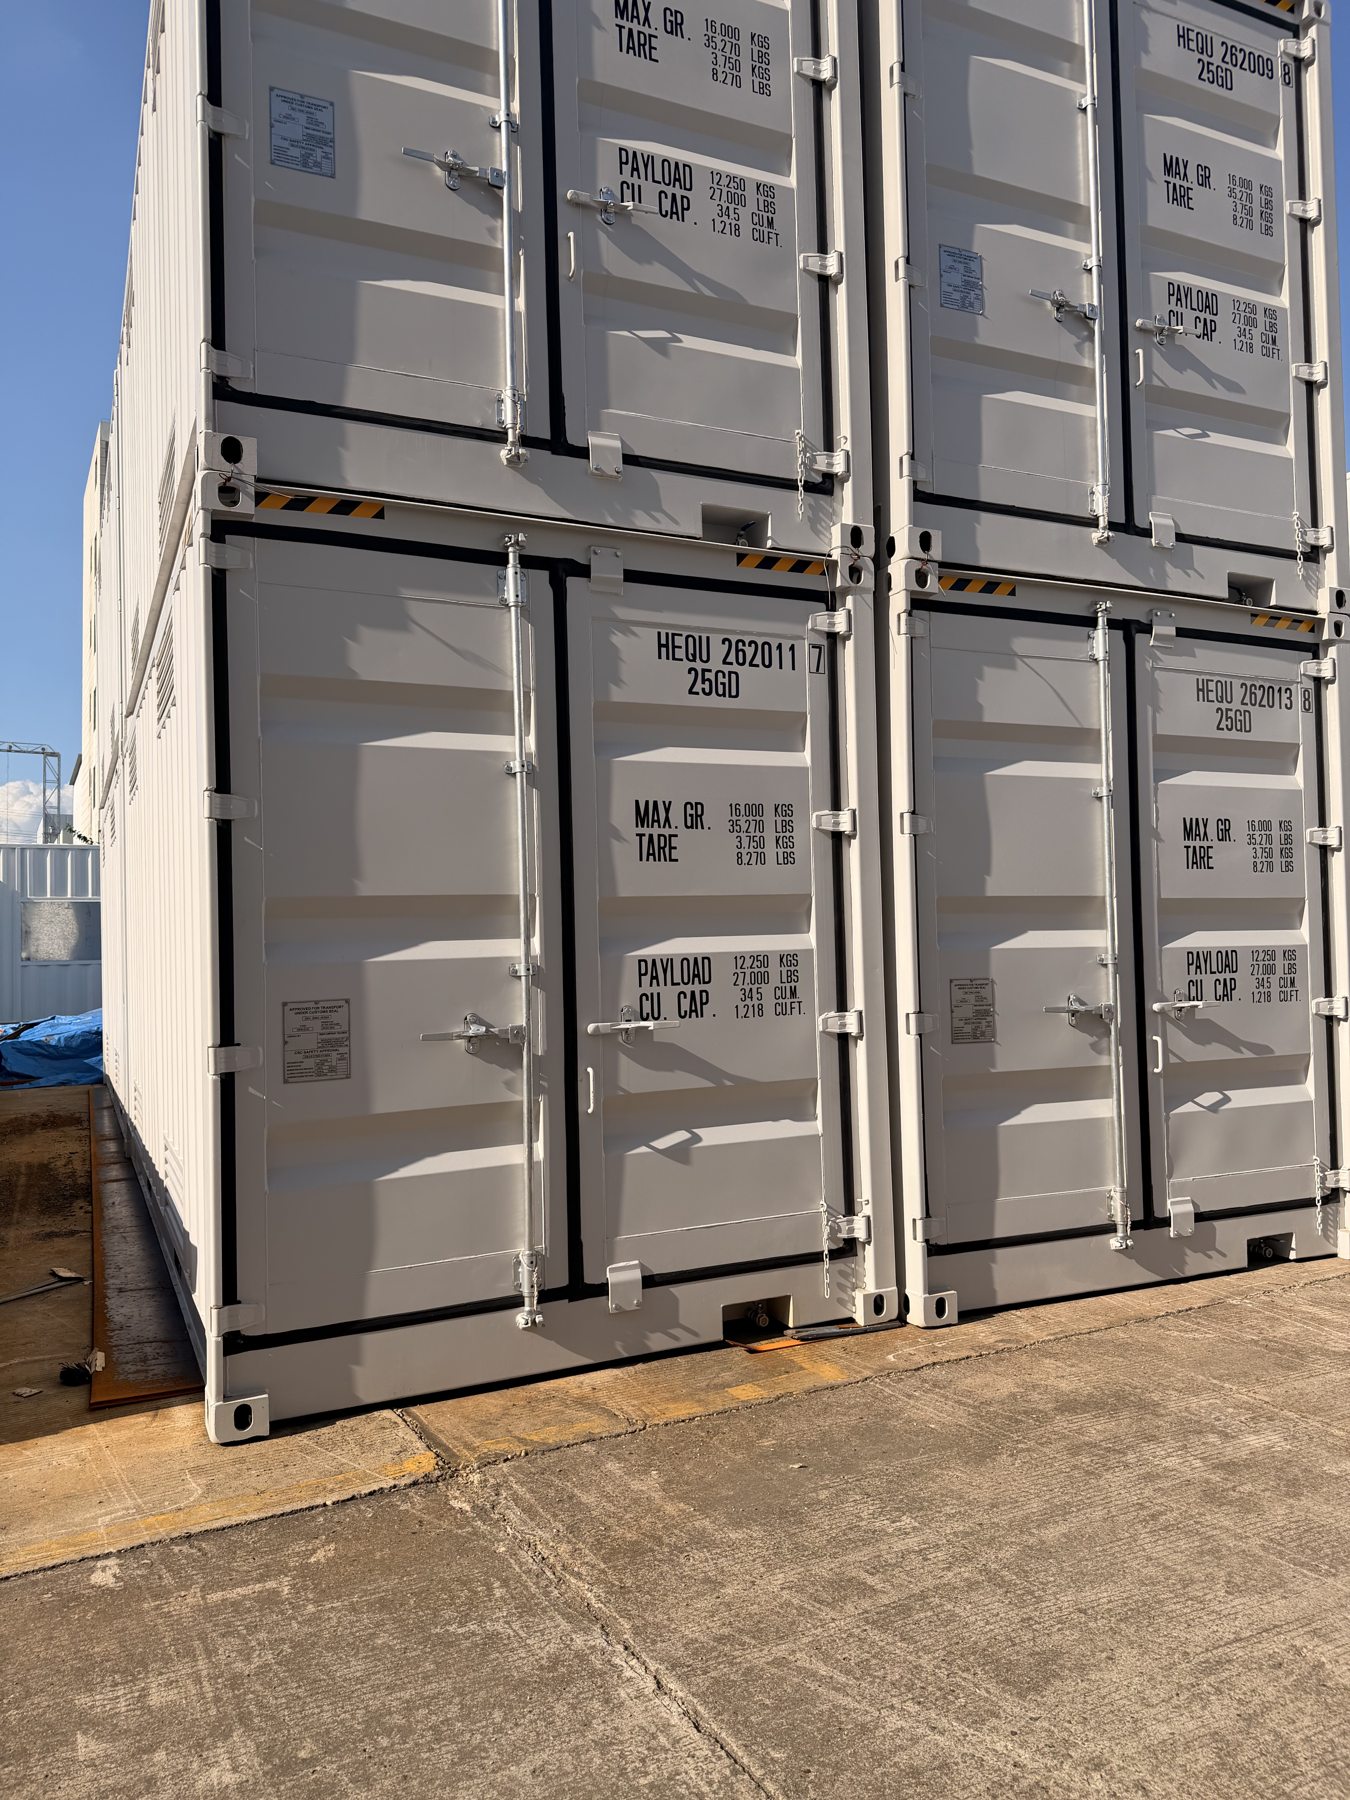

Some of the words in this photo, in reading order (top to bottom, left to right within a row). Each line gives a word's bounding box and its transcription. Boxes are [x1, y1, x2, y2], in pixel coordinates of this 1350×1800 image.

[614, 0, 658, 31] MAX.
[663, 7, 691, 41] GR.
[615, 23, 659, 63] TARE
[705, 18, 740, 42] 16.000
[750, 31, 770, 50] KGS
[704, 33, 741, 57] 35.270
[751, 47, 770, 66] LBS
[1177, 24, 1214, 58] HEQU
[1221, 41, 1274, 80] 262009
[711, 51, 741, 73] 3.750
[751, 63, 771, 82] KGS
[1197, 58, 1233, 91] 25GD
[712, 67, 742, 89] 8.270
[752, 79, 771, 97] LBS
[618, 147, 693, 192] PAYLOAD
[1163, 152, 1193, 184] MAX.
[1196, 163, 1216, 191] GR.
[710, 170, 746, 192] 12.250
[756, 182, 775, 200] KGS
[1164, 180, 1194, 211] TARE
[1228, 173, 1253, 192] 16.000
[1259, 184, 1273, 198] KGS
[658, 190, 697, 225] CAP.
[709, 186, 746, 208] 27.000
[756, 197, 776, 215] LBS
[1227, 186, 1253, 205] 35.270
[1260, 196, 1273, 211] LBS
[716, 203, 740, 222] 34.5
[751, 211, 777, 231] CU.M.
[1232, 200, 1253, 218] 3.750
[1260, 209, 1273, 224] KGS
[712, 218, 741, 238] 1.218
[752, 227, 782, 248] CU.FT.
[1232, 214, 1254, 231] 8.270
[1260, 222, 1273, 237] LBS
[1167, 281, 1218, 317] PAYLOAD
[1232, 299, 1257, 316] 12.250
[1263, 307, 1278, 321] KGS
[1195, 316, 1222, 344] CAP.
[1232, 312, 1258, 329] 27.000
[1264, 320, 1278, 334] LBS
[1237, 326, 1253, 341] 34.5
[1233, 338, 1254, 354] 1.218
[657, 631, 711, 664] HEQU
[721, 637, 796, 671] 262011
[687, 667, 740, 699] 25GD
[1196, 678, 1233, 704] HEQU
[1240, 682, 1293, 710] 262013
[1216, 707, 1252, 733] 25GD
[635, 799, 678, 829] MAX.
[683, 801, 711, 830] GR.
[729, 803, 764, 818] 16.000
[774, 803, 794, 818] KGS
[728, 819, 764, 834] 35.270
[774, 819, 794, 834] LBS
[1182, 817, 1213, 842] MAX.
[1216, 818, 1236, 842] GR.
[1247, 819, 1272, 832] 16.000
[1279, 820, 1293, 832] KGS
[635, 833, 679, 862] TARE
[735, 835, 765, 850] 3.750
[775, 835, 795, 849] KGS
[1246, 833, 1273, 846] 35.270
[1279, 833, 1293, 846] LBS
[736, 851, 766, 866] 8.270
[776, 851, 796, 865] LBS
[1183, 845, 1214, 870] TARE
[1252, 847, 1273, 859] 3.750
[1280, 847, 1293, 859] KGS
[1252, 860, 1274, 873] 8.270
[1280, 860, 1294, 873] LBS
[734, 954, 769, 970] 12.250
[779, 953, 799, 968] KGS
[1187, 949, 1238, 976] PAYLOAD
[1251, 949, 1276, 962] 12.250
[1283, 949, 1297, 961] KGS
[638, 956, 712, 988] PAYLOAD
[733, 970, 770, 986] 27.000
[780, 969, 799, 984] LBS
[1250, 963, 1276, 976] 27.000
[1283, 962, 1297, 975] LBS
[774, 985, 800, 1000] CU.M.
[1214, 977, 1241, 1002] CAP.
[1255, 977, 1271, 989] 34.5
[639, 992, 667, 1021] CU.
[677, 989, 716, 1019] CAP.
[1251, 990, 1271, 1003] 1.218
[735, 1003, 764, 1019] 1.218
[774, 1000, 806, 1017] CU.FT.
